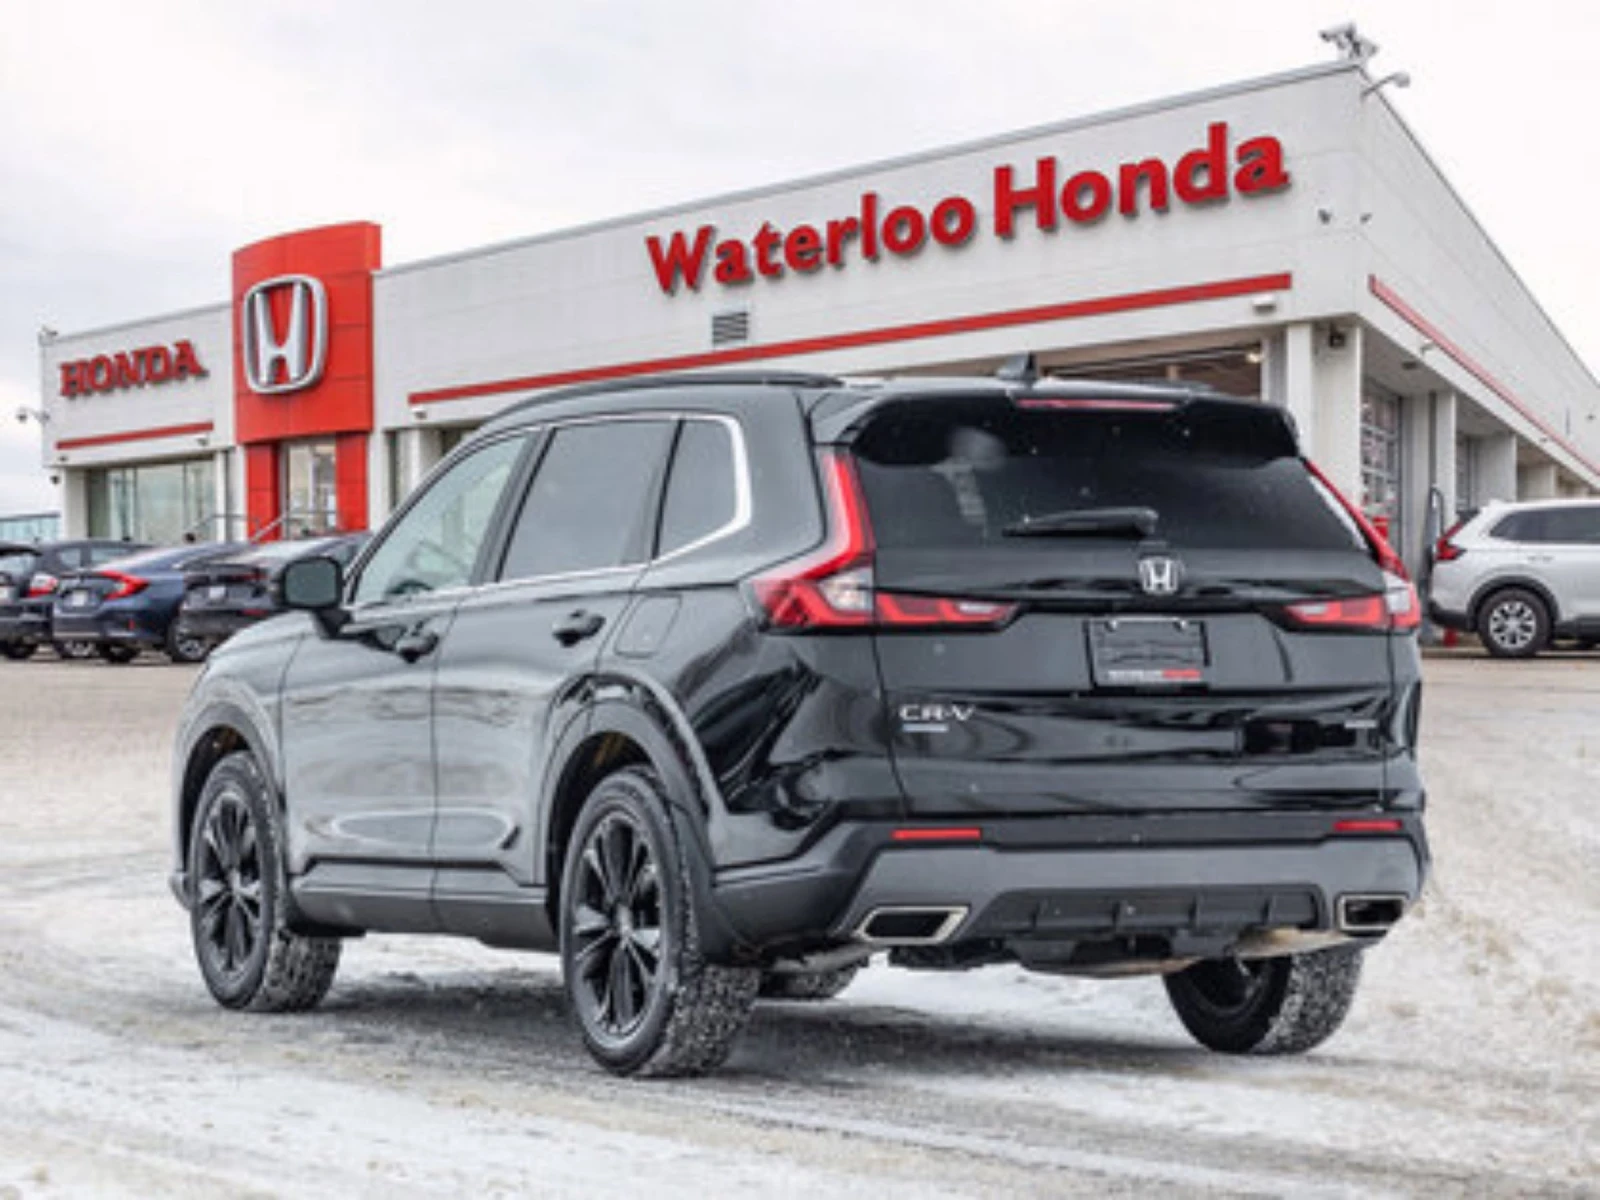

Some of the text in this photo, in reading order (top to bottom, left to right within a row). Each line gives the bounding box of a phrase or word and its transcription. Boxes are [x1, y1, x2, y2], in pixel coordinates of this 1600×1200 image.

[646, 121, 1290, 294] Waterloo Honda
[59, 339, 206, 398] HONDA
